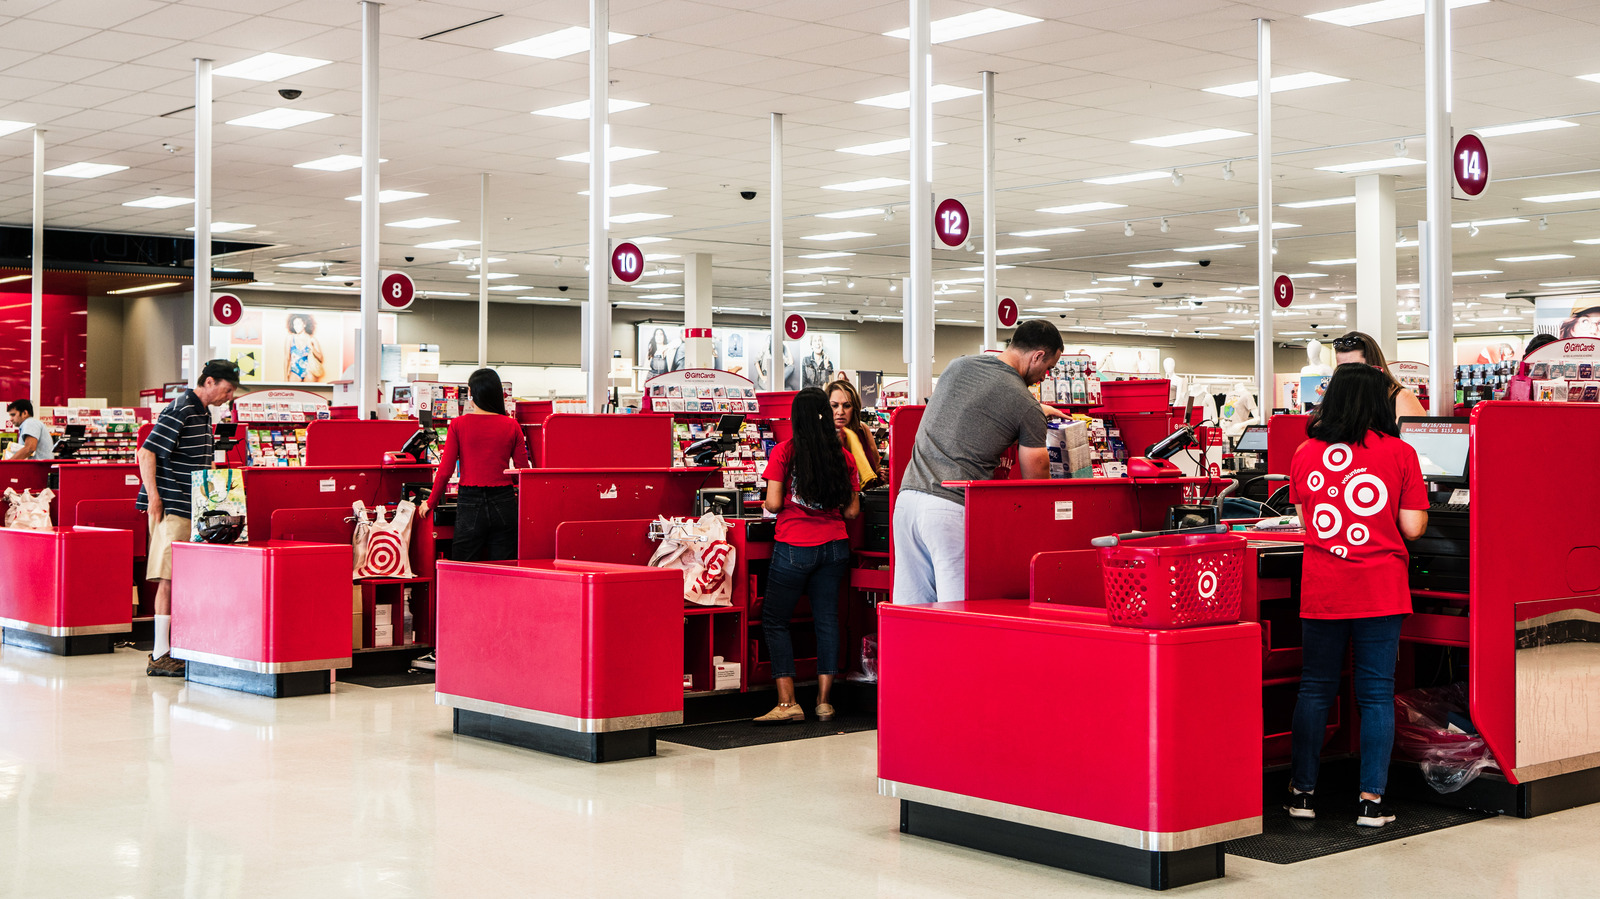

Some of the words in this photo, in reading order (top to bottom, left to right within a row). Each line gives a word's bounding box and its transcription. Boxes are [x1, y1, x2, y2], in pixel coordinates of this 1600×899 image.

[1459, 149, 1481, 181] 14
[941, 210, 962, 235] 12
[617, 252, 637, 273] 10
[392, 282, 402, 299] 8
[1280, 284, 1287, 299] 9
[222, 303, 232, 318] 6
[1003, 305, 1011, 319] 7
[791, 320, 799, 333] 5
[1570, 343, 1595, 352] GiftCards
[1341, 467, 1368, 485] volunteer
